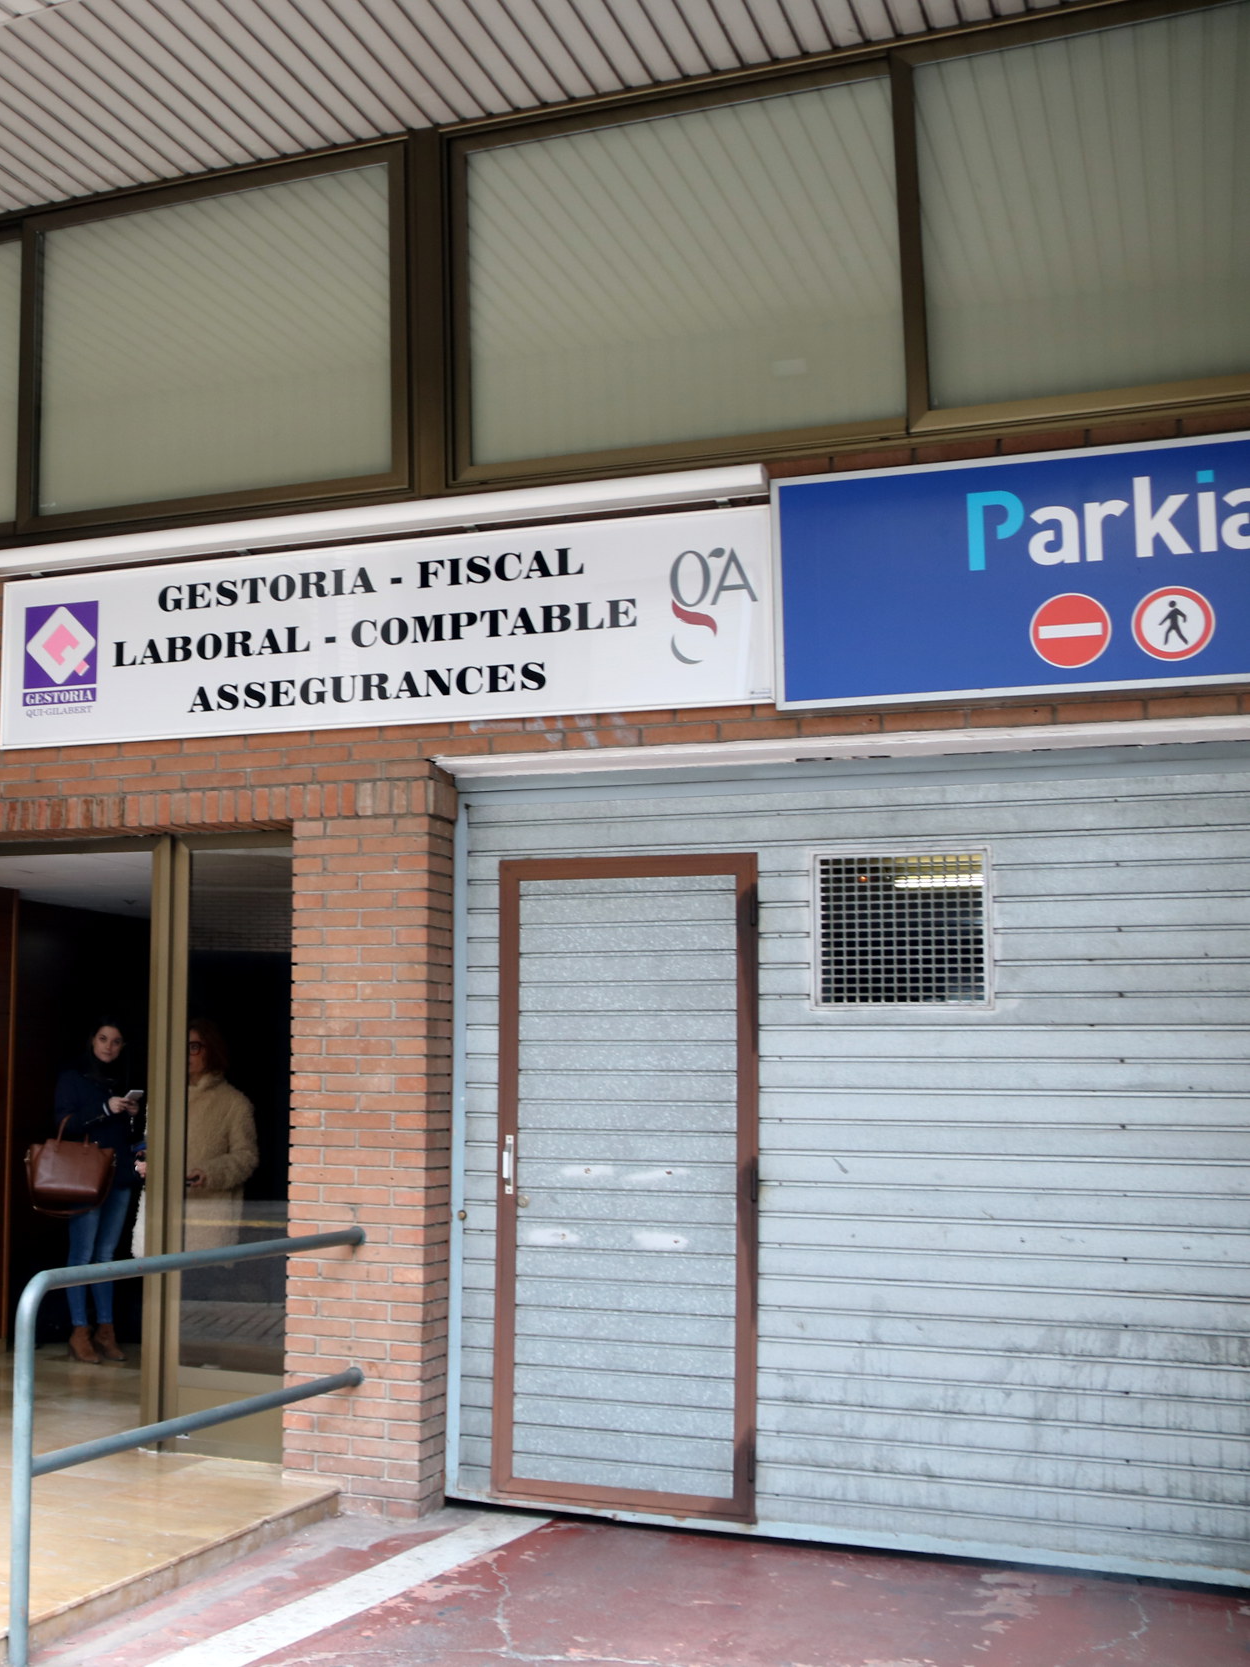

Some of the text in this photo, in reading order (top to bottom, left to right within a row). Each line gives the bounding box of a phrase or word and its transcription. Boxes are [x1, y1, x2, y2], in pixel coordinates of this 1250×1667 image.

[158, 567, 378, 613] GESTORIA
[417, 547, 585, 589] FISCAL
[113, 626, 311, 668] LABORAL
[351, 598, 637, 648] COMPTABLE
[25, 689, 93, 704] GESTORIA
[25, 705, 93, 718] QUI-GILABERT
[187, 661, 547, 713] ASSEGURANCES
